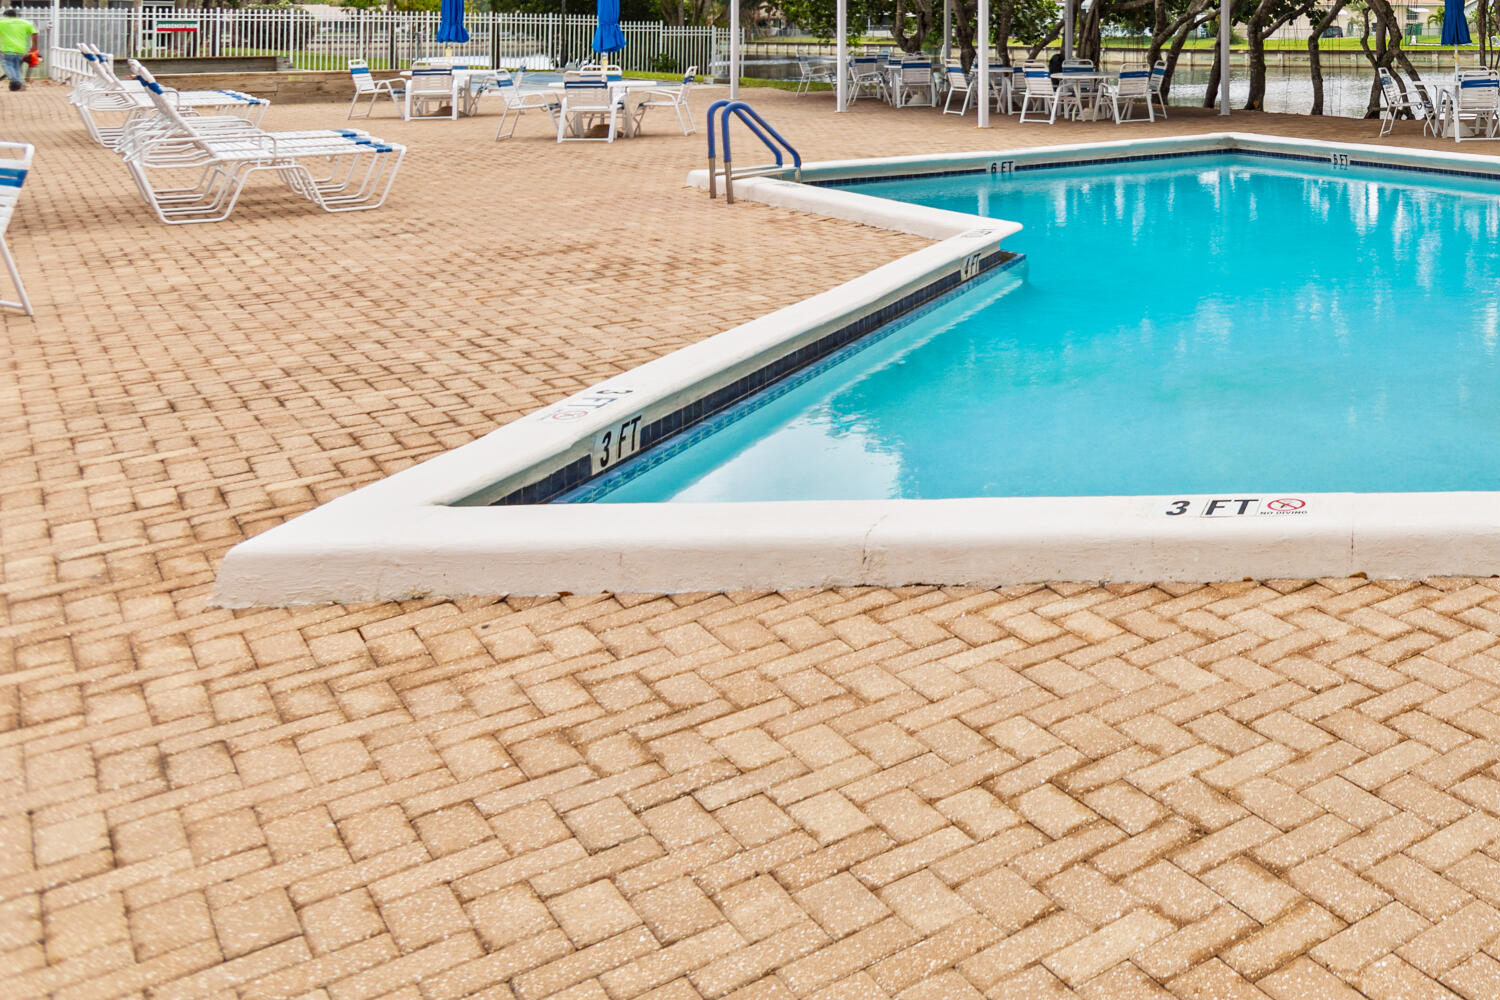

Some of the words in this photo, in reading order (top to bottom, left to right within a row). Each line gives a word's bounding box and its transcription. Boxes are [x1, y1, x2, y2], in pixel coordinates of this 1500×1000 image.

[991, 162, 997, 173] 6
[1001, 160, 1014, 173] FT
[600, 431, 612, 467] 3
[618, 415, 642, 459] FT
[1165, 500, 1190, 515] 3
[1205, 499, 1259, 515] FT
